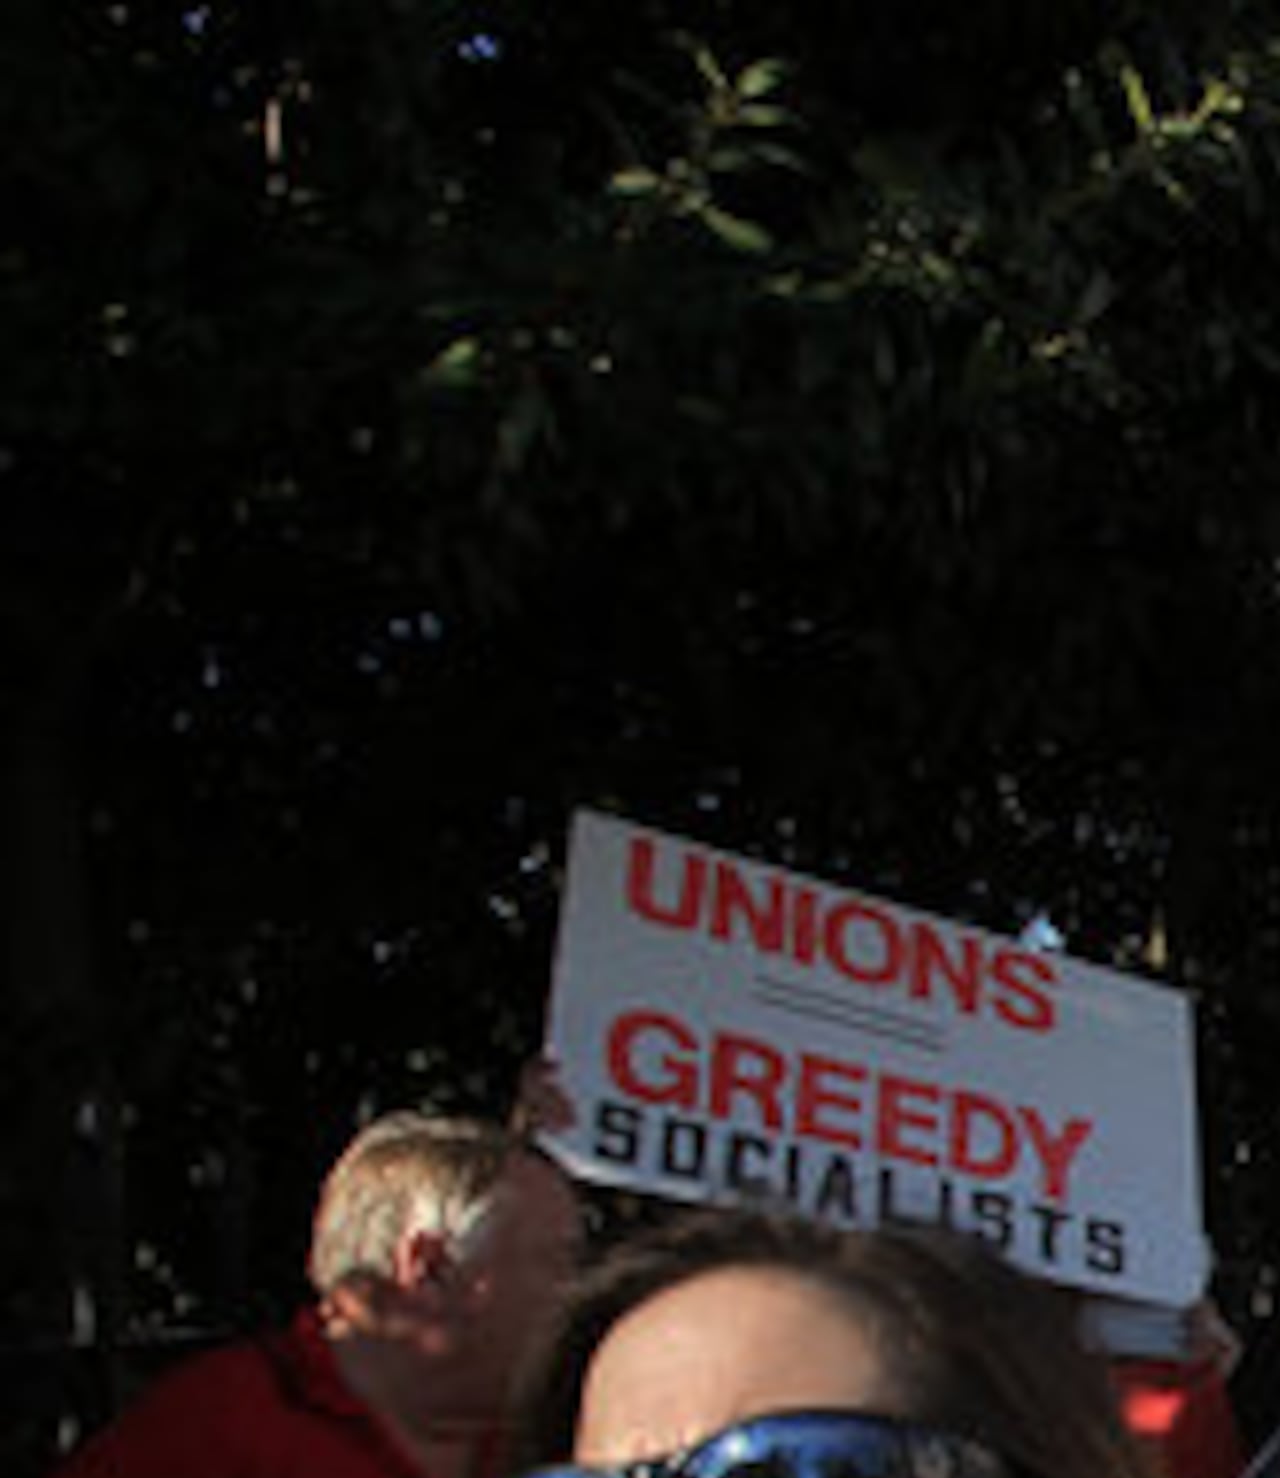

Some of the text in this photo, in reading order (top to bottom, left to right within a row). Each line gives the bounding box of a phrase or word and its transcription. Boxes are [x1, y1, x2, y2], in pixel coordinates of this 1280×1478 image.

[624, 836, 1057, 1033] UNIONS
[594, 1099, 1126, 1276] SOCIALISTS
[605, 1010, 1093, 1201] GREEDY
